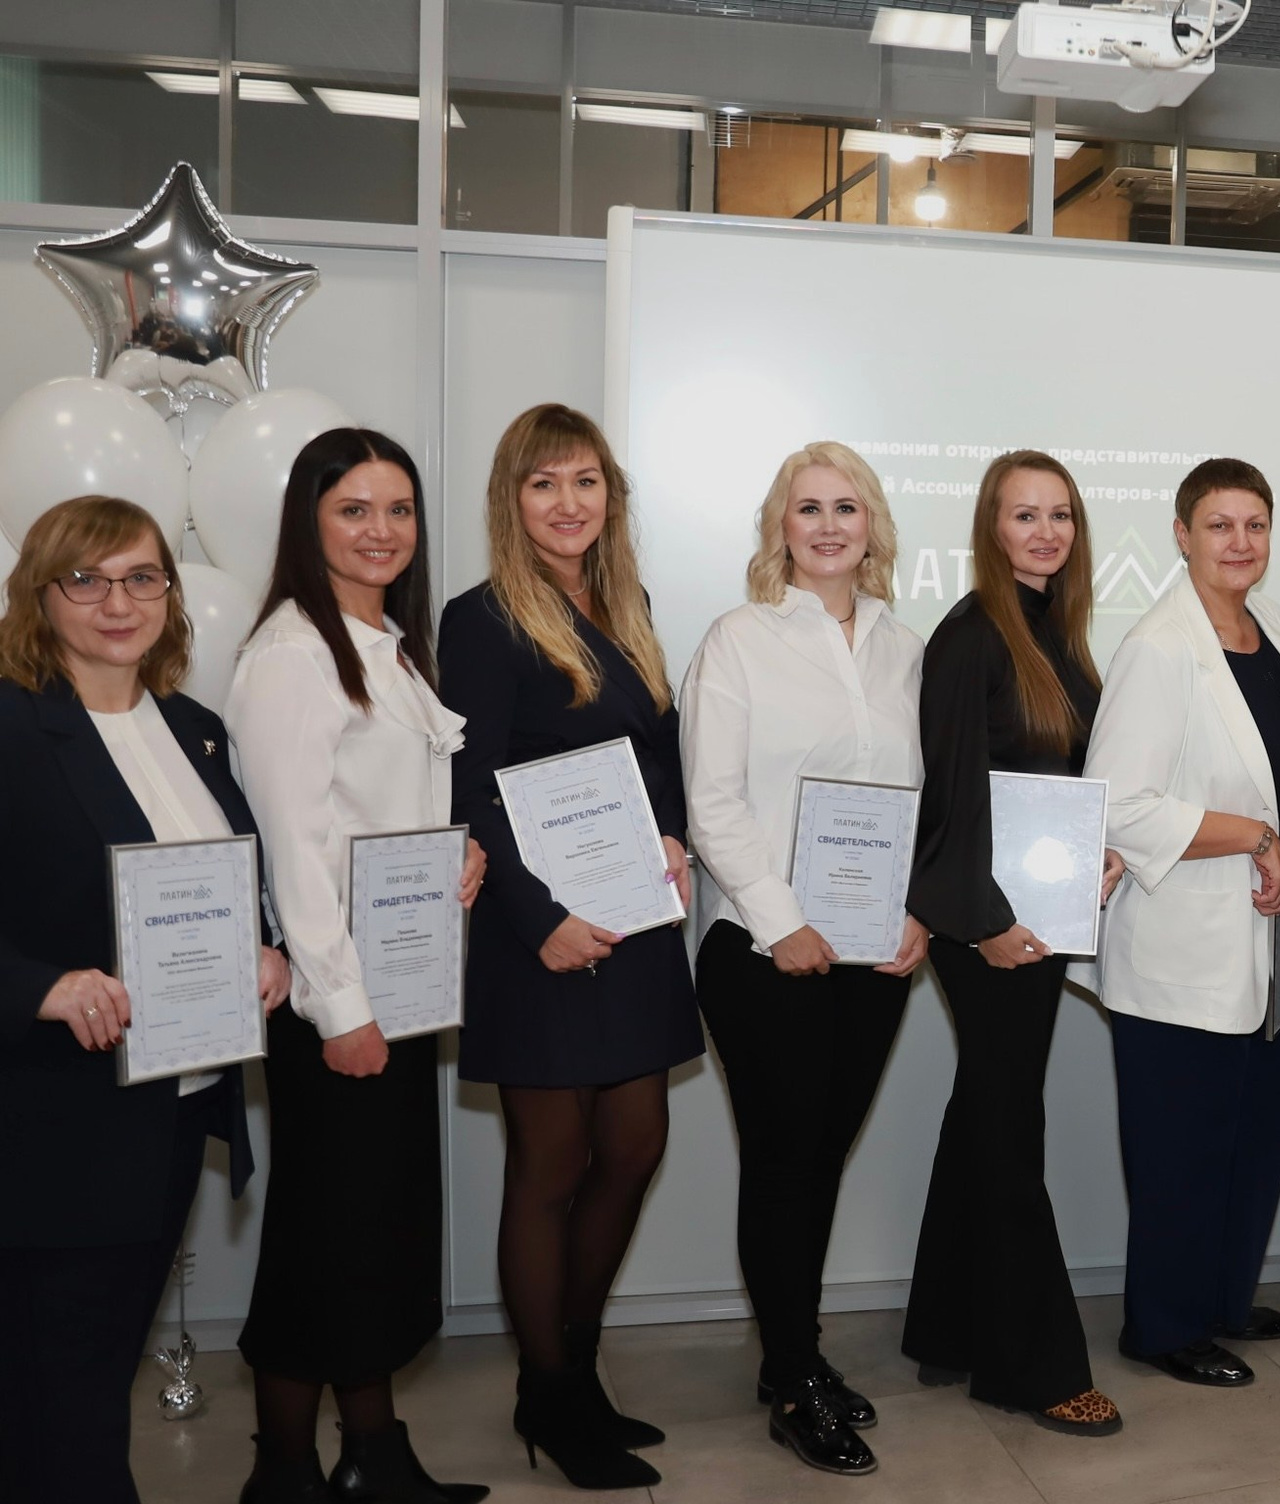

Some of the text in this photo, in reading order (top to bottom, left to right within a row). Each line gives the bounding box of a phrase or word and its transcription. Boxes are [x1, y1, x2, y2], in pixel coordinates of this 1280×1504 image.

[541, 801, 622, 829] СВИДЕТЕЛЬСТВО
[817, 835, 892, 849] СВИДЕТЕЛЬСТВО
[372, 891, 443, 908] СВИДЕТЕЛЬСТВО
[145, 908, 231, 926] СВИДЕТЕЛЬСТВО
